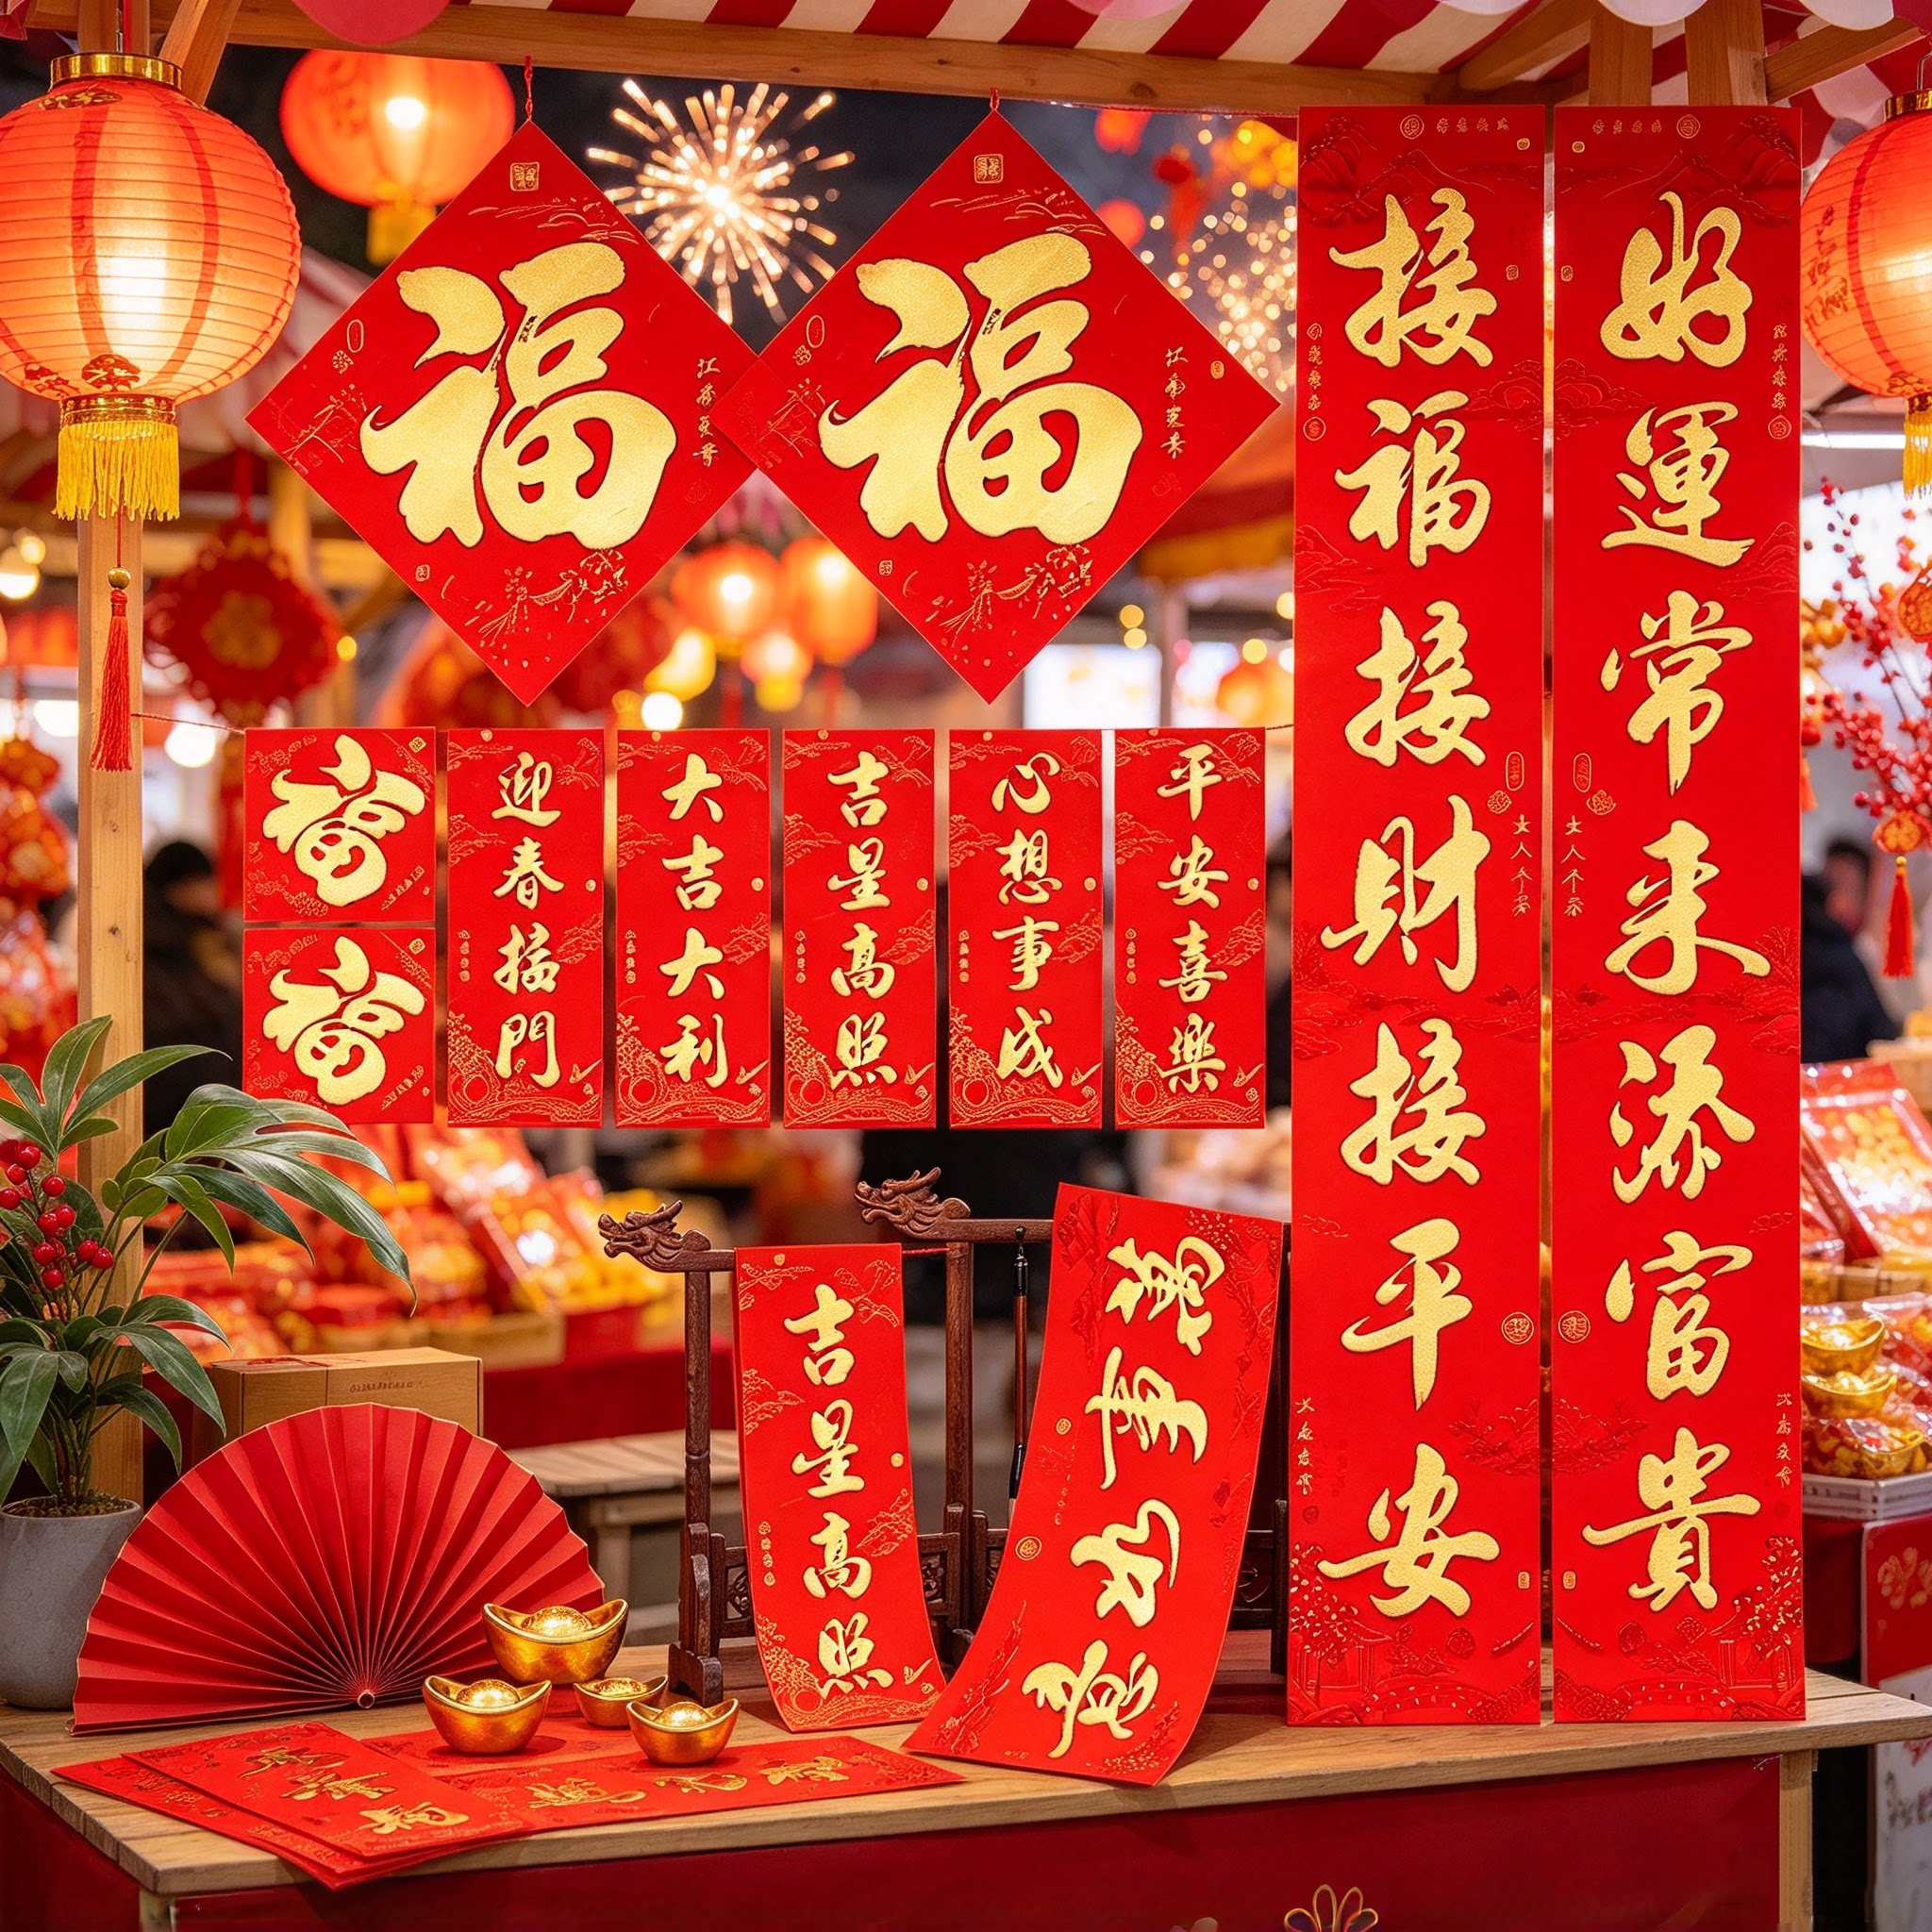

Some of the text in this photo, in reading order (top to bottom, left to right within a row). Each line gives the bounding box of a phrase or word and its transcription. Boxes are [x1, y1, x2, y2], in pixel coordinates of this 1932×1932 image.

[360, 242, 678, 549] 福
[819, 233, 1144, 544] 福
[262, 735, 425, 907] 福
[659, 752, 730, 1089] 大吉大利
[826, 751, 897, 1091] 吉星高照
[991, 752, 1063, 1089] 心想事成
[1157, 743, 1230, 1093] 平安喜樂
[1318, 188, 1500, 1617] 接福接財接平安
[262, 936, 425, 1106] 福
[783, 1284, 894, 1701] 吉星高照
